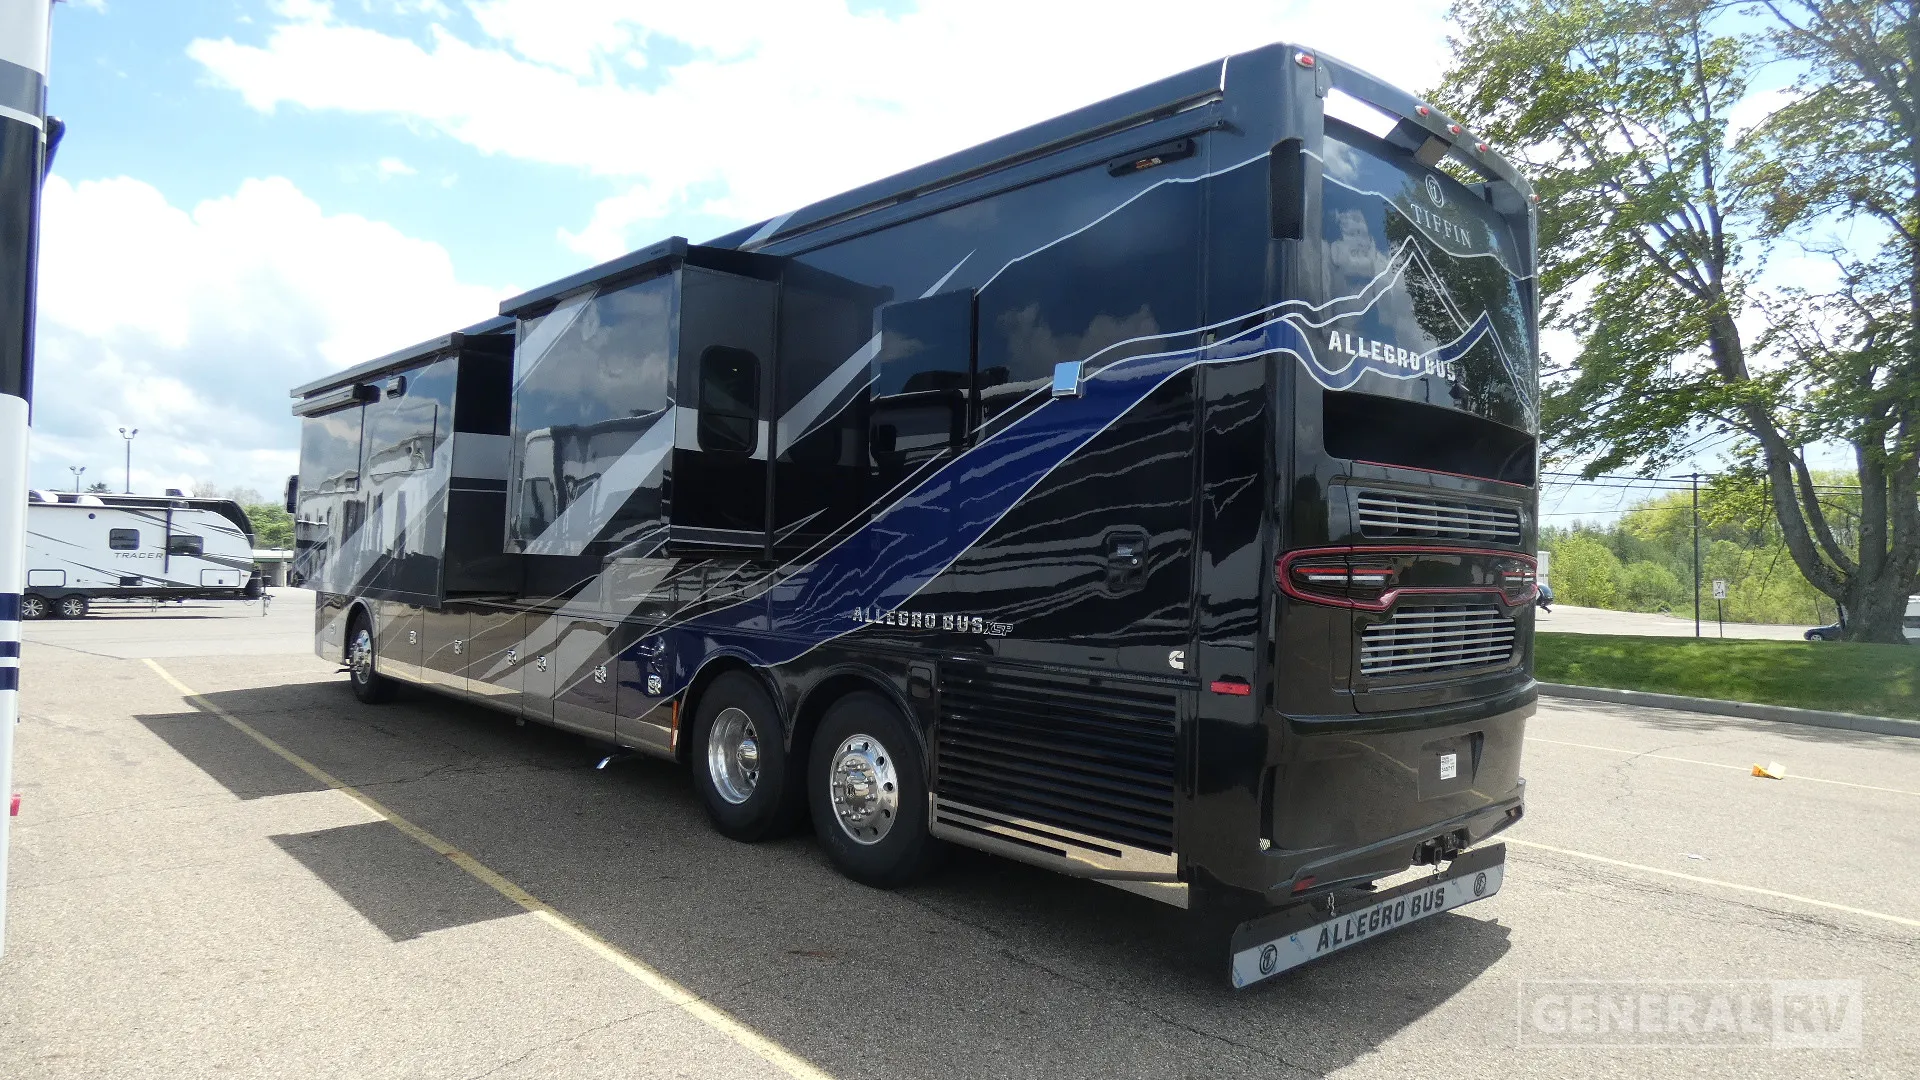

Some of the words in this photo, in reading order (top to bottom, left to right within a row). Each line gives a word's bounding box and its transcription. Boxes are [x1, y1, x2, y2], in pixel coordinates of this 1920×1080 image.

[1410, 203, 1472, 249] TIFFIN
[1328, 330, 1420, 370] ALLEGRO
[1424, 357, 1456, 382] BUS
[852, 606, 936, 628] ALLEGRO
[942, 614, 983, 634] BUS
[983, 621, 1014, 636] XSP
[1316, 900, 1405, 952] ALLEGRO
[1411, 887, 1445, 917] BUS
